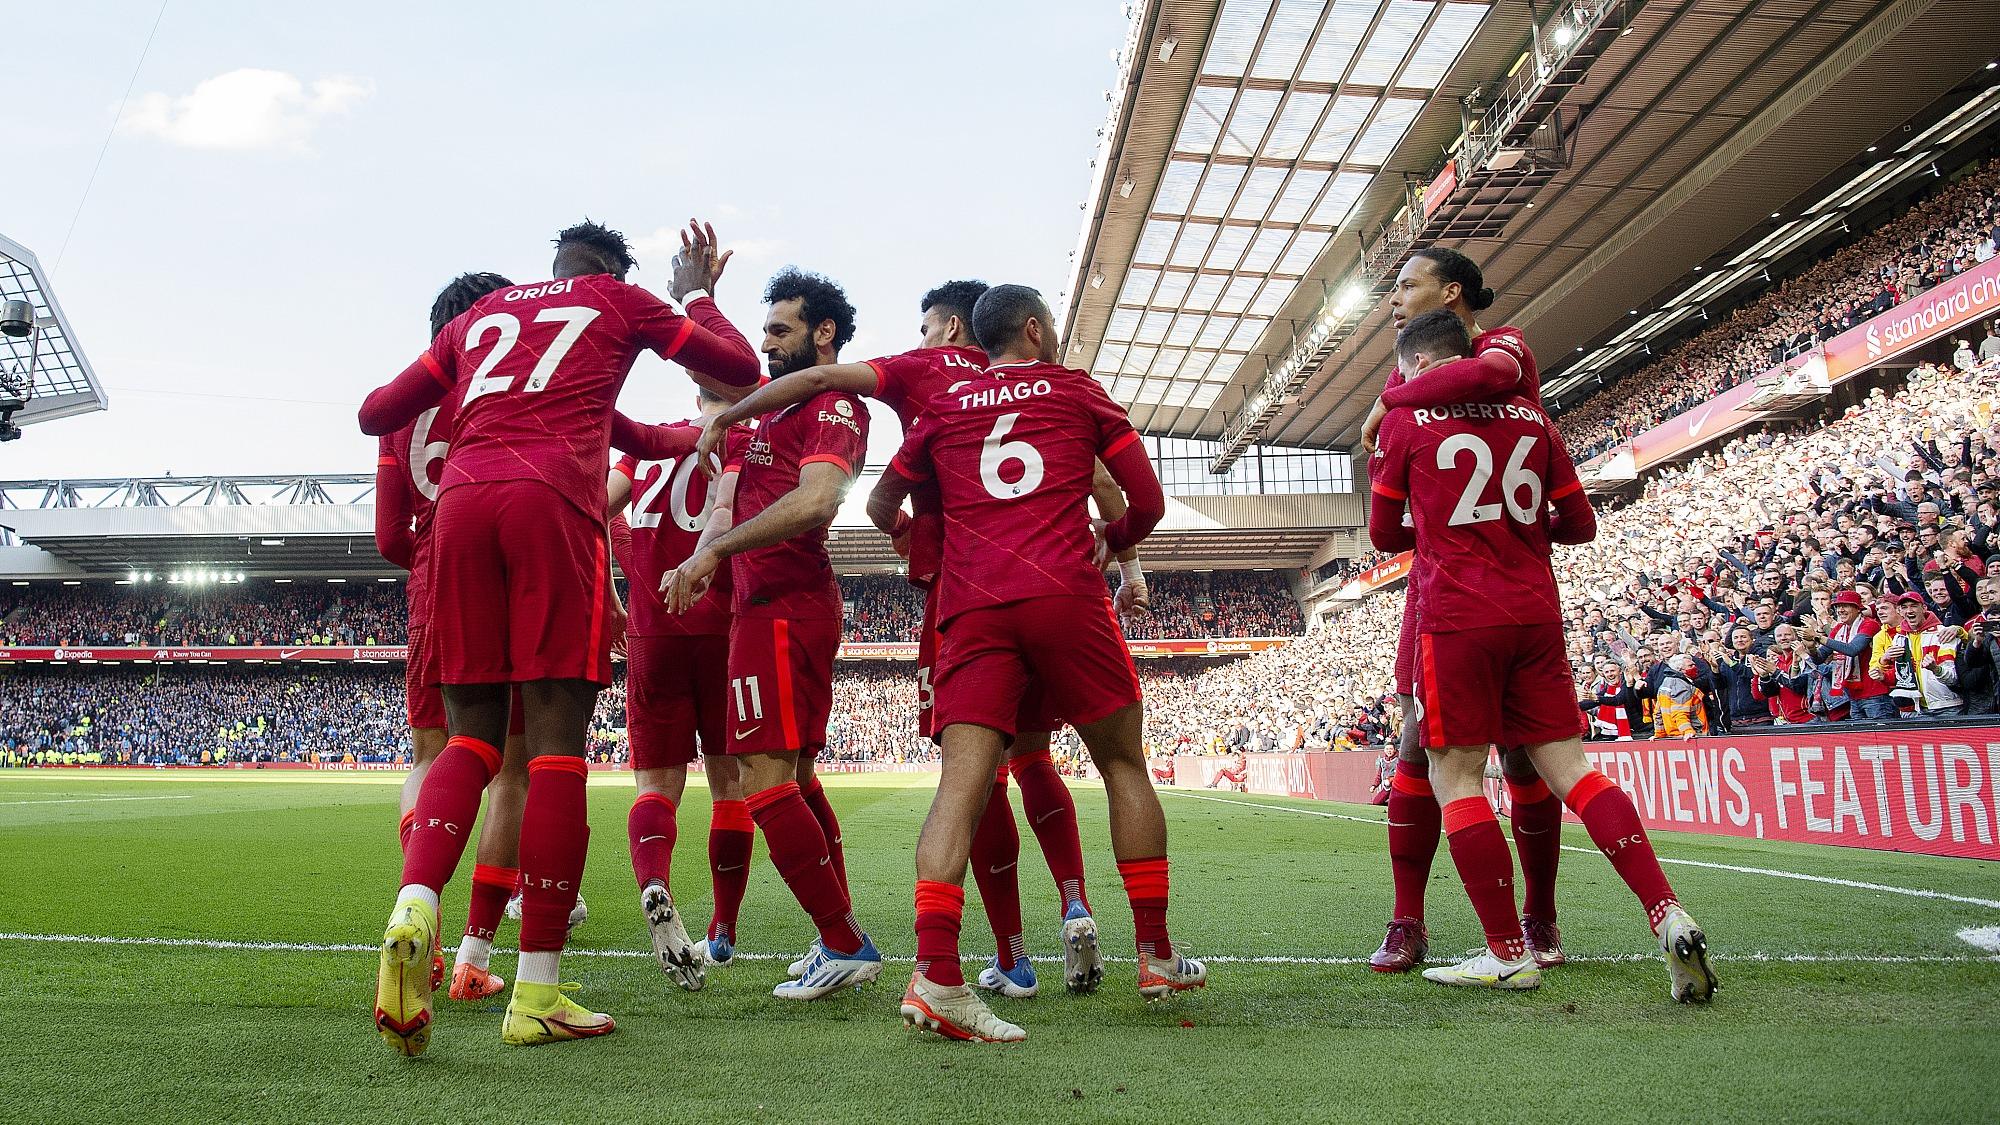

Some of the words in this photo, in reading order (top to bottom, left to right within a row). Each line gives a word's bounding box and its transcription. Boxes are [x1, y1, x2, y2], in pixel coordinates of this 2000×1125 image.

[504, 279, 574, 301] ORIGI
[1884, 283, 1970, 347] standard
[461, 306, 601, 408] 27
[959, 380, 1051, 409] THIAGO
[818, 411, 860, 436] Expedia
[1413, 403, 1544, 427] ROBERTSON
[980, 412, 1043, 499] 6
[631, 451, 722, 532] 20
[1437, 433, 1541, 526] 26
[64, 650, 93, 659] Expedia
[362, 650, 399, 658] standard
[846, 647, 887, 656] standard
[732, 675, 763, 722] 11
